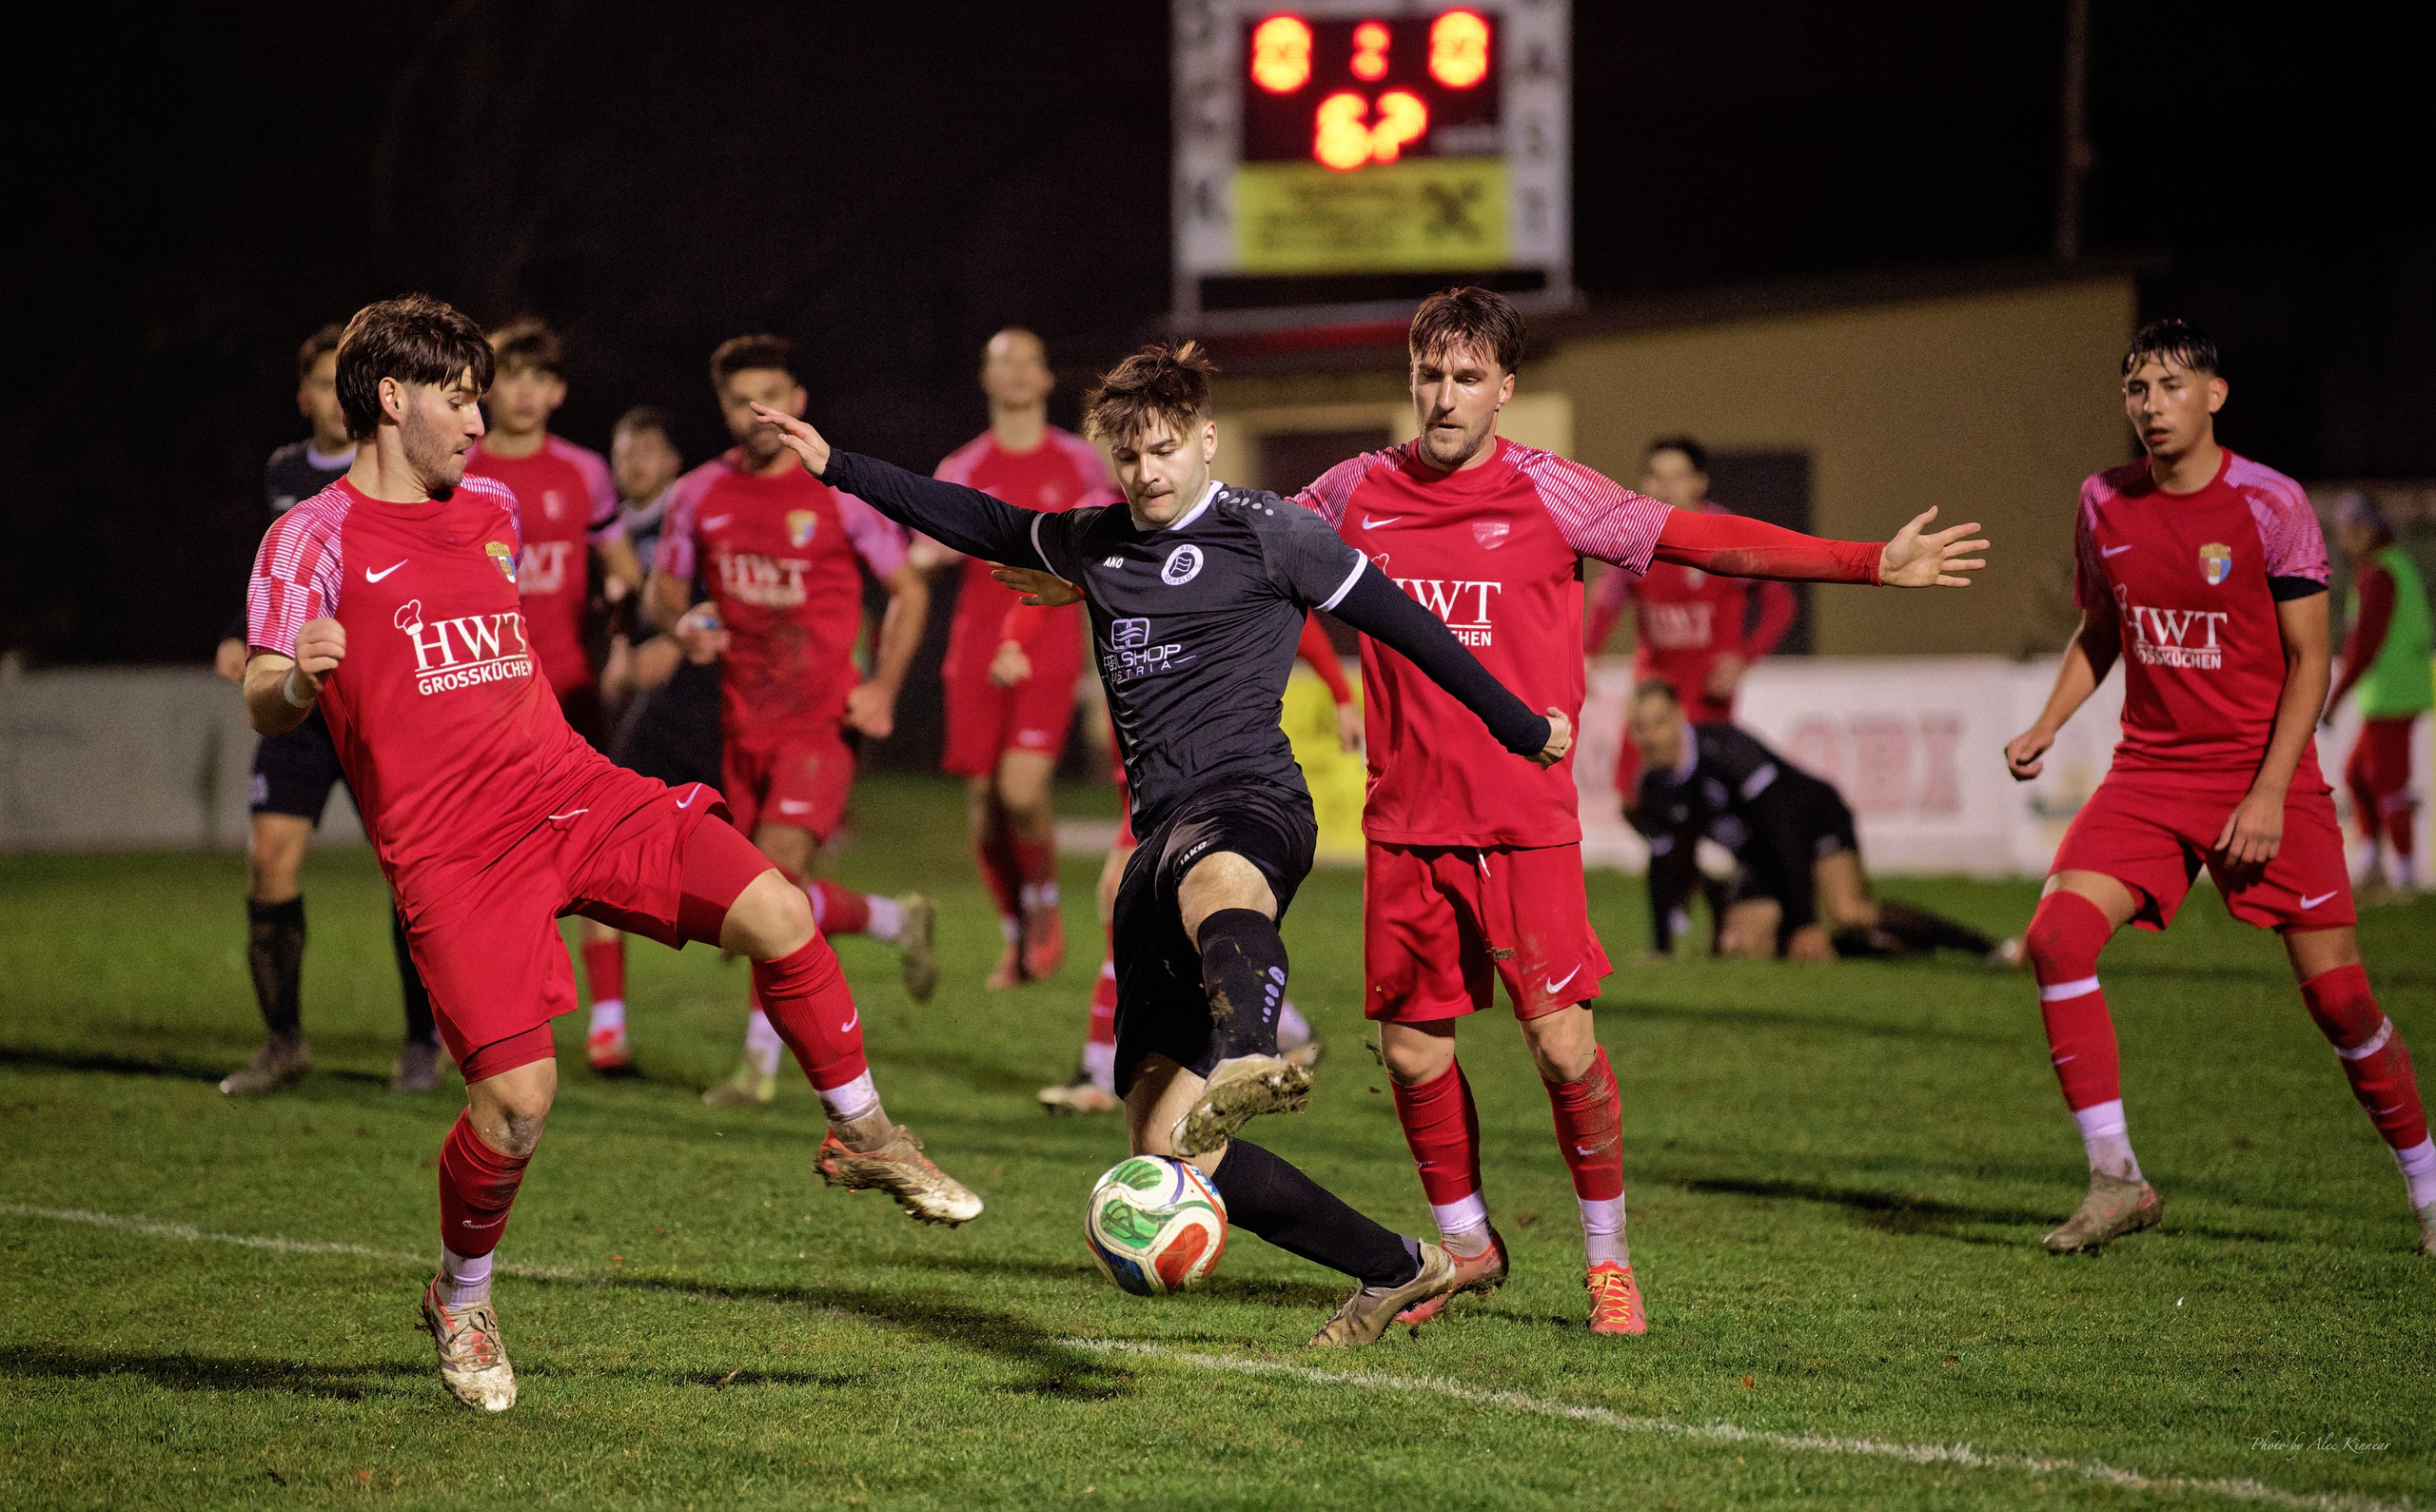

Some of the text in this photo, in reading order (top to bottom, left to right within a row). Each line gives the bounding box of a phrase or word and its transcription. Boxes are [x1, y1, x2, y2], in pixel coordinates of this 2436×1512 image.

[1103, 557, 1124, 569] AKO
[419, 660, 533, 696] GROSSKÜCHEN
[1110, 660, 1171, 683] USTRIA
